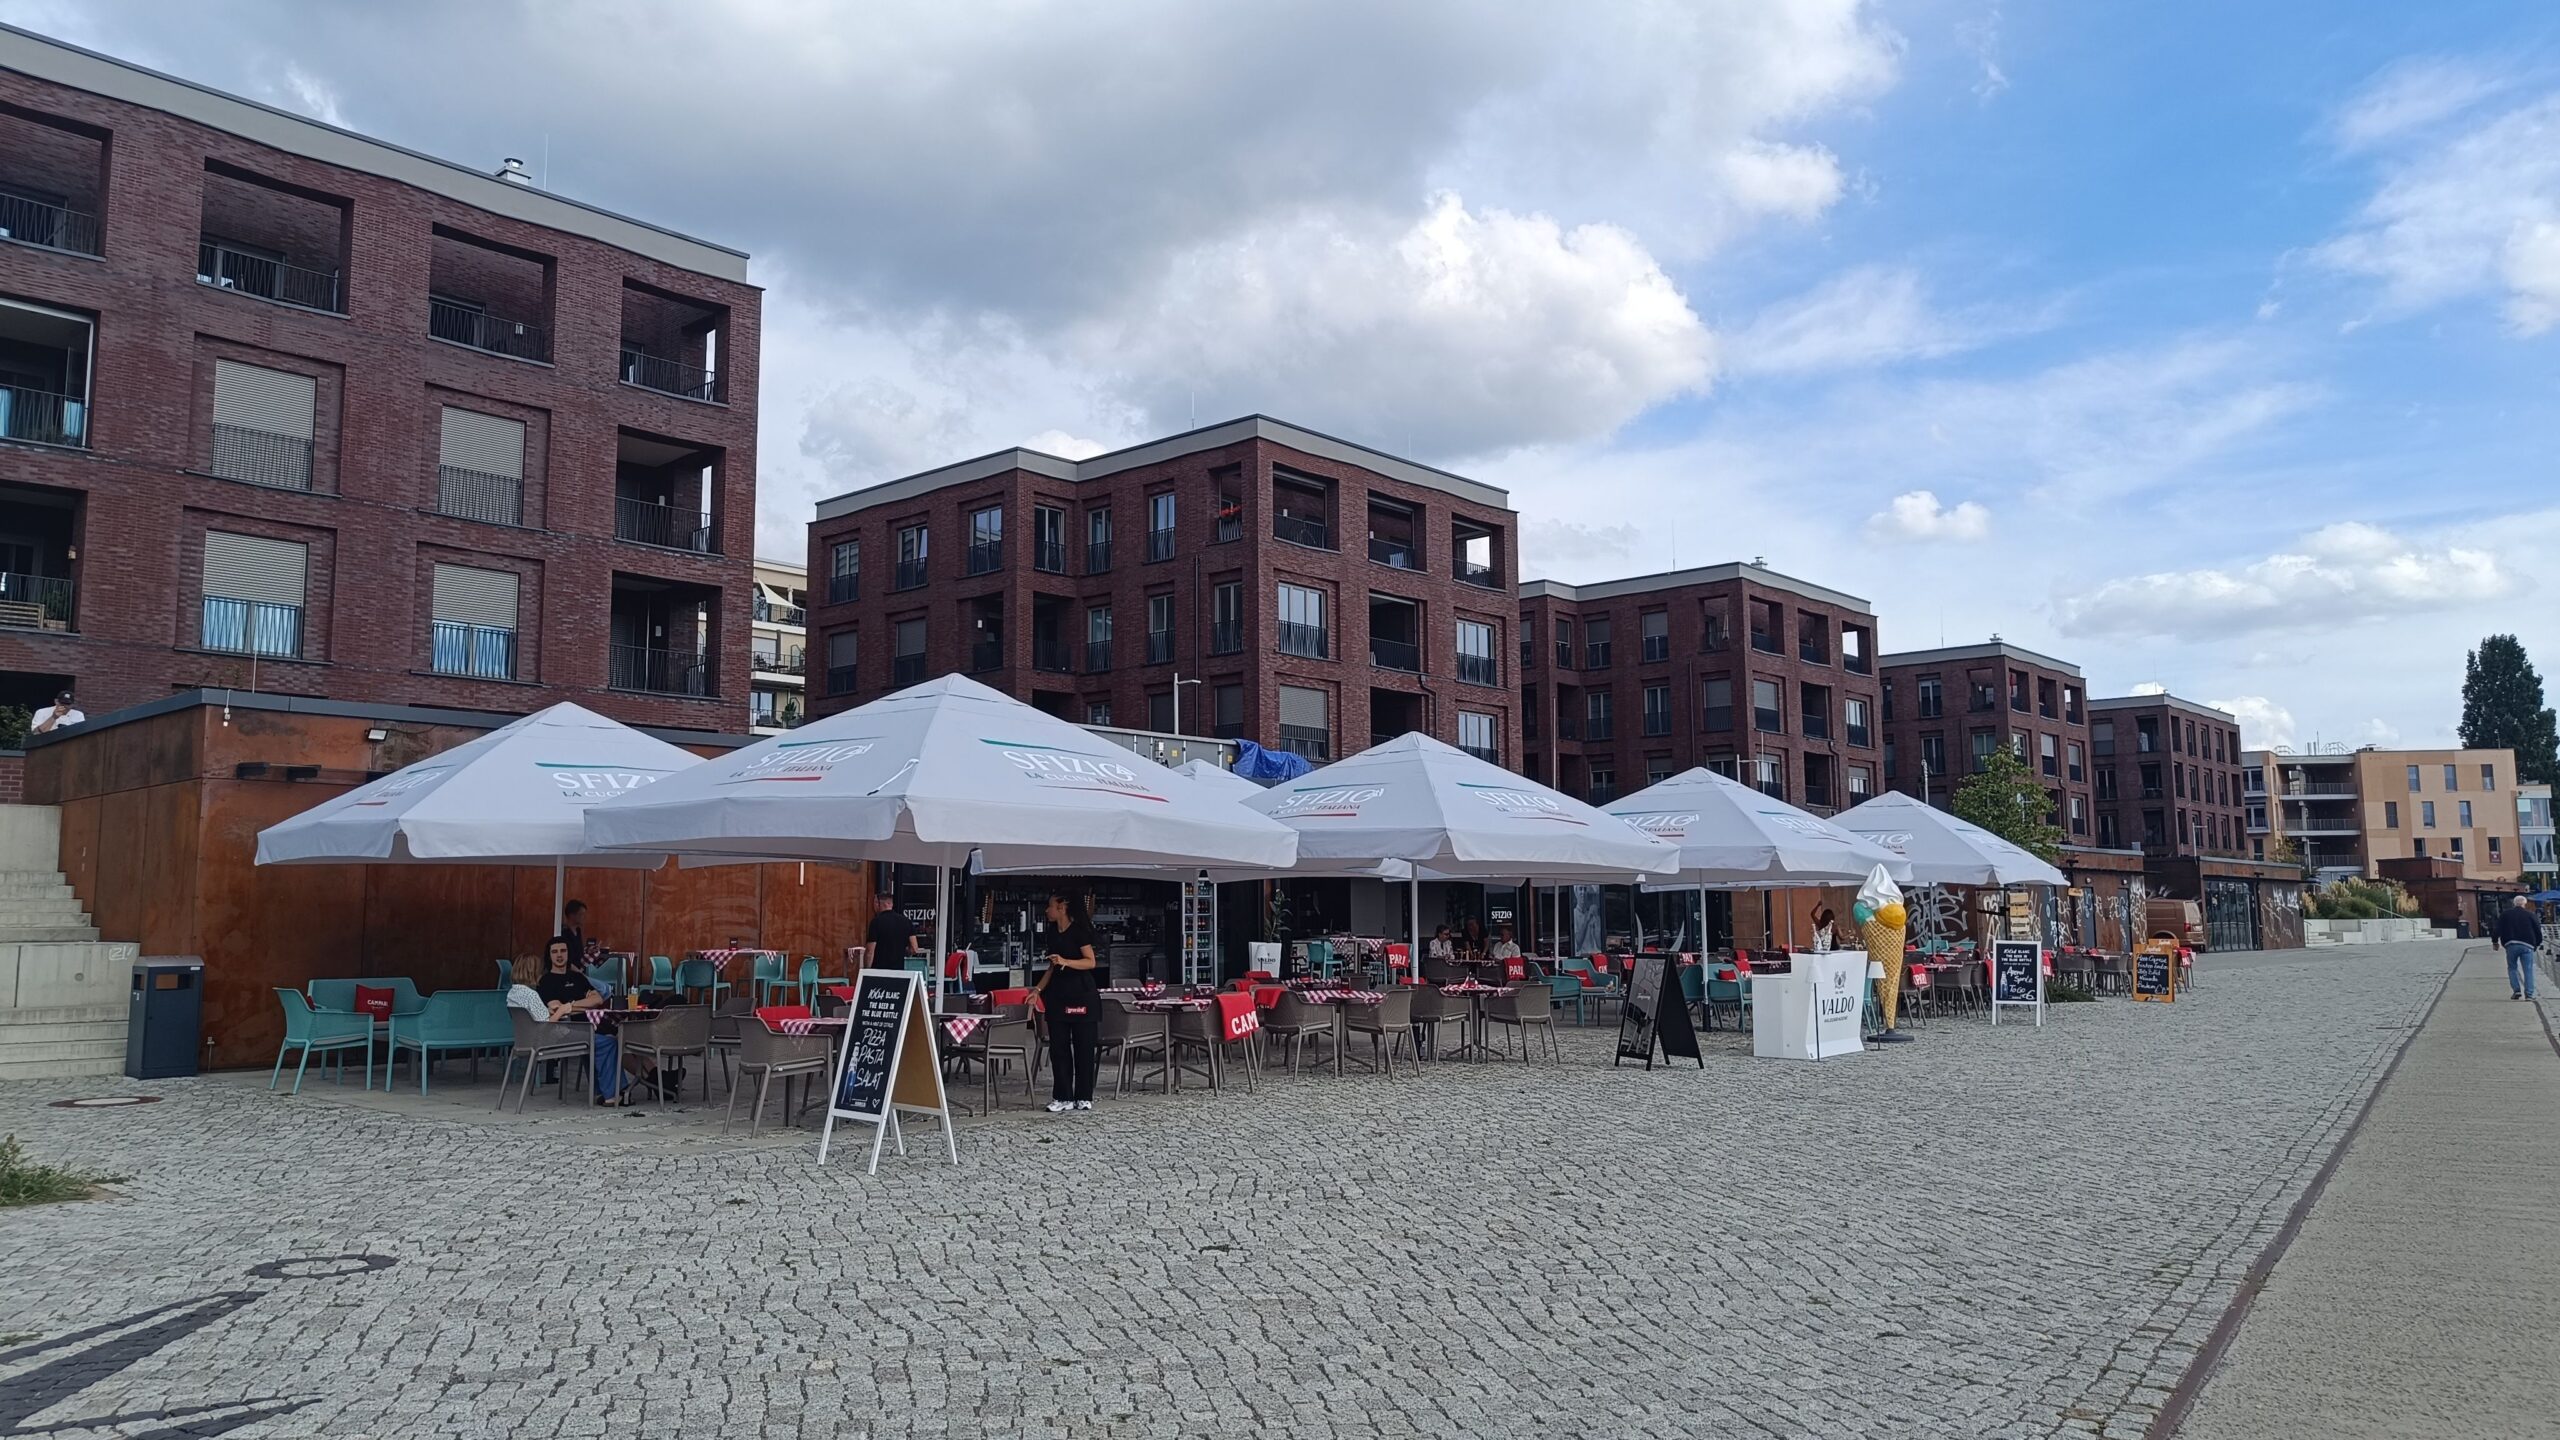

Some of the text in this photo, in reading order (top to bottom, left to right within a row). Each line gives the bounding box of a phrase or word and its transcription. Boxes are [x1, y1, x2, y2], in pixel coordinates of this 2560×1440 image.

[1002, 750, 1137, 782] SFIZIO
[552, 772, 657, 789] SFIZ
[584, 790, 626, 798] CUCI
[1277, 788, 1384, 809] SFIZIO
[903, 908, 936, 920] SFIZIO
[1491, 911, 1513, 919] SFIZIO
[885, 991, 901, 1000] BLANC
[862, 1009, 899, 1019] THE BLUE BOTTLE
[869, 1001, 878, 1009] THE
[878, 1002, 889, 1010] BEER
[1822, 996, 1855, 1015] VALDO
[1231, 1010, 1260, 1035] CAM
[862, 1028, 887, 1046] PIZZA
[858, 1044, 885, 1065] PASTA
[854, 1068, 884, 1090] SALAT
